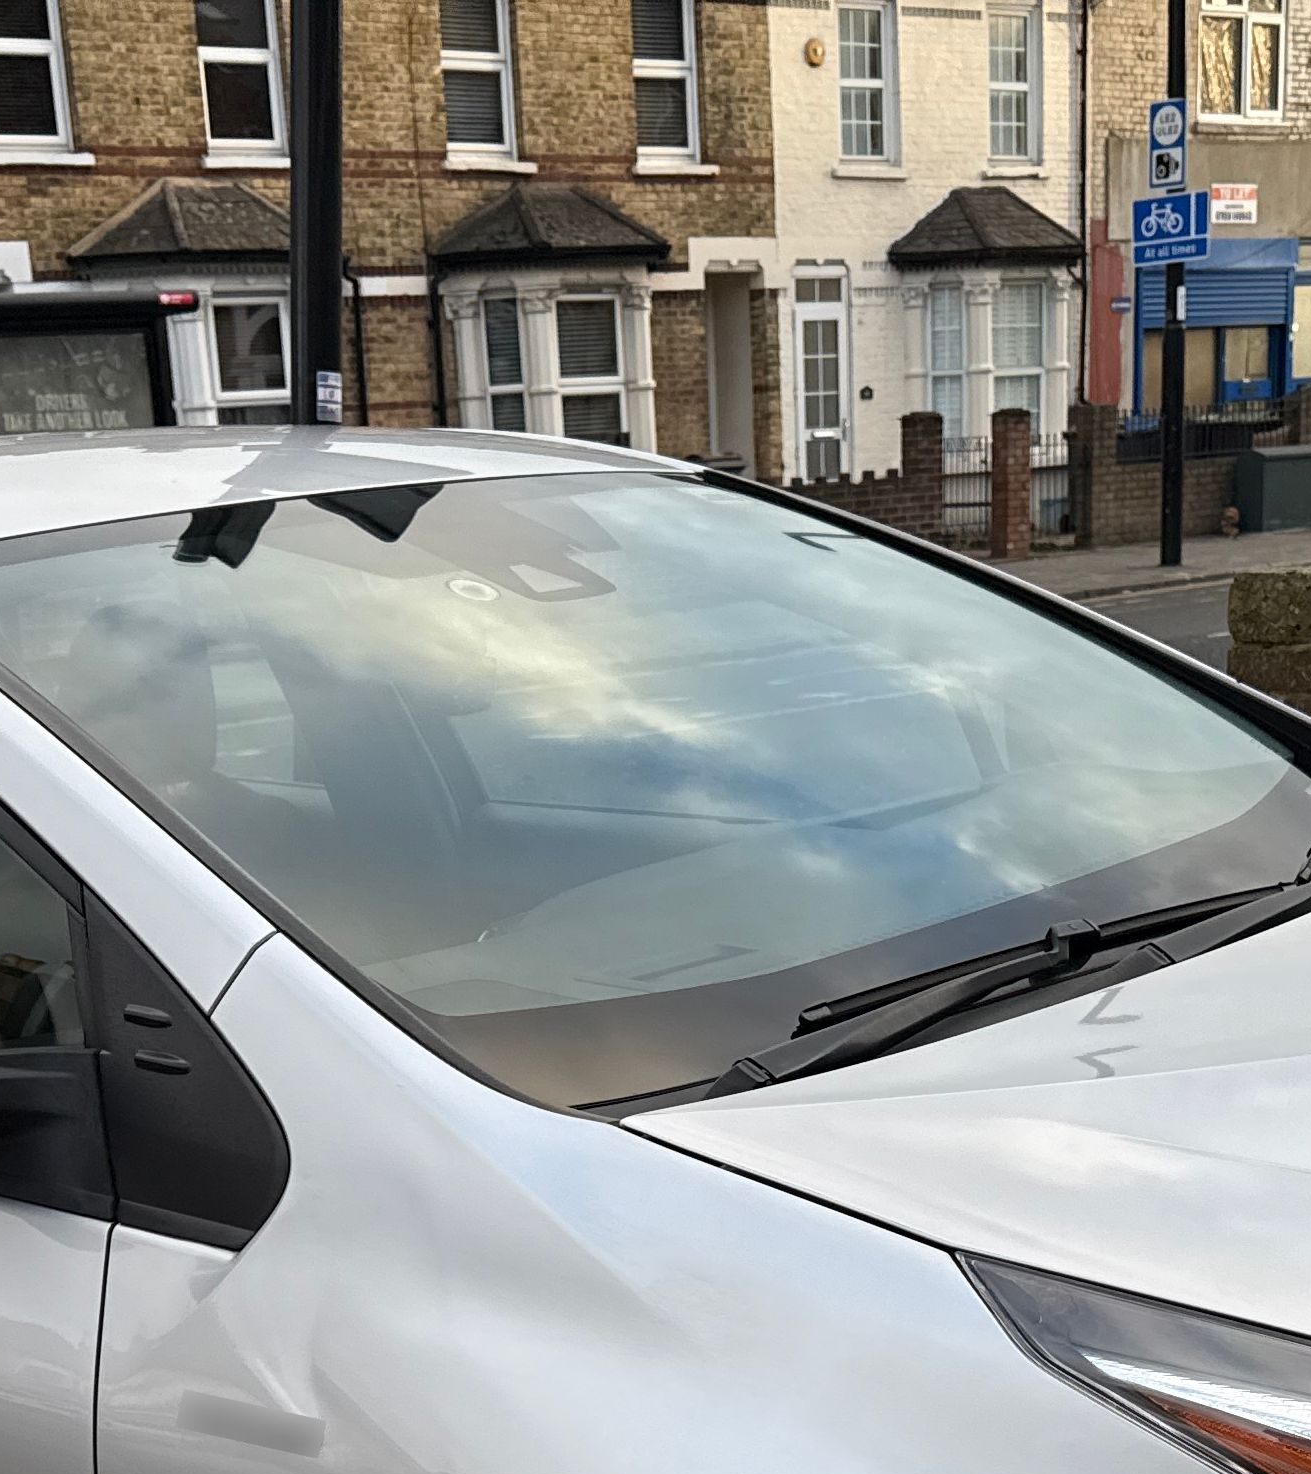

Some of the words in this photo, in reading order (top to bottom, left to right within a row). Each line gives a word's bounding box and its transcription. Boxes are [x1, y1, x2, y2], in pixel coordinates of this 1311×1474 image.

[1144, 246, 1156, 259] At
[1157, 246, 1170, 258] all
[1171, 243, 1197, 256] times
[36, 411, 94, 430] ANOTHER
[94, 409, 130, 429] LOOK
